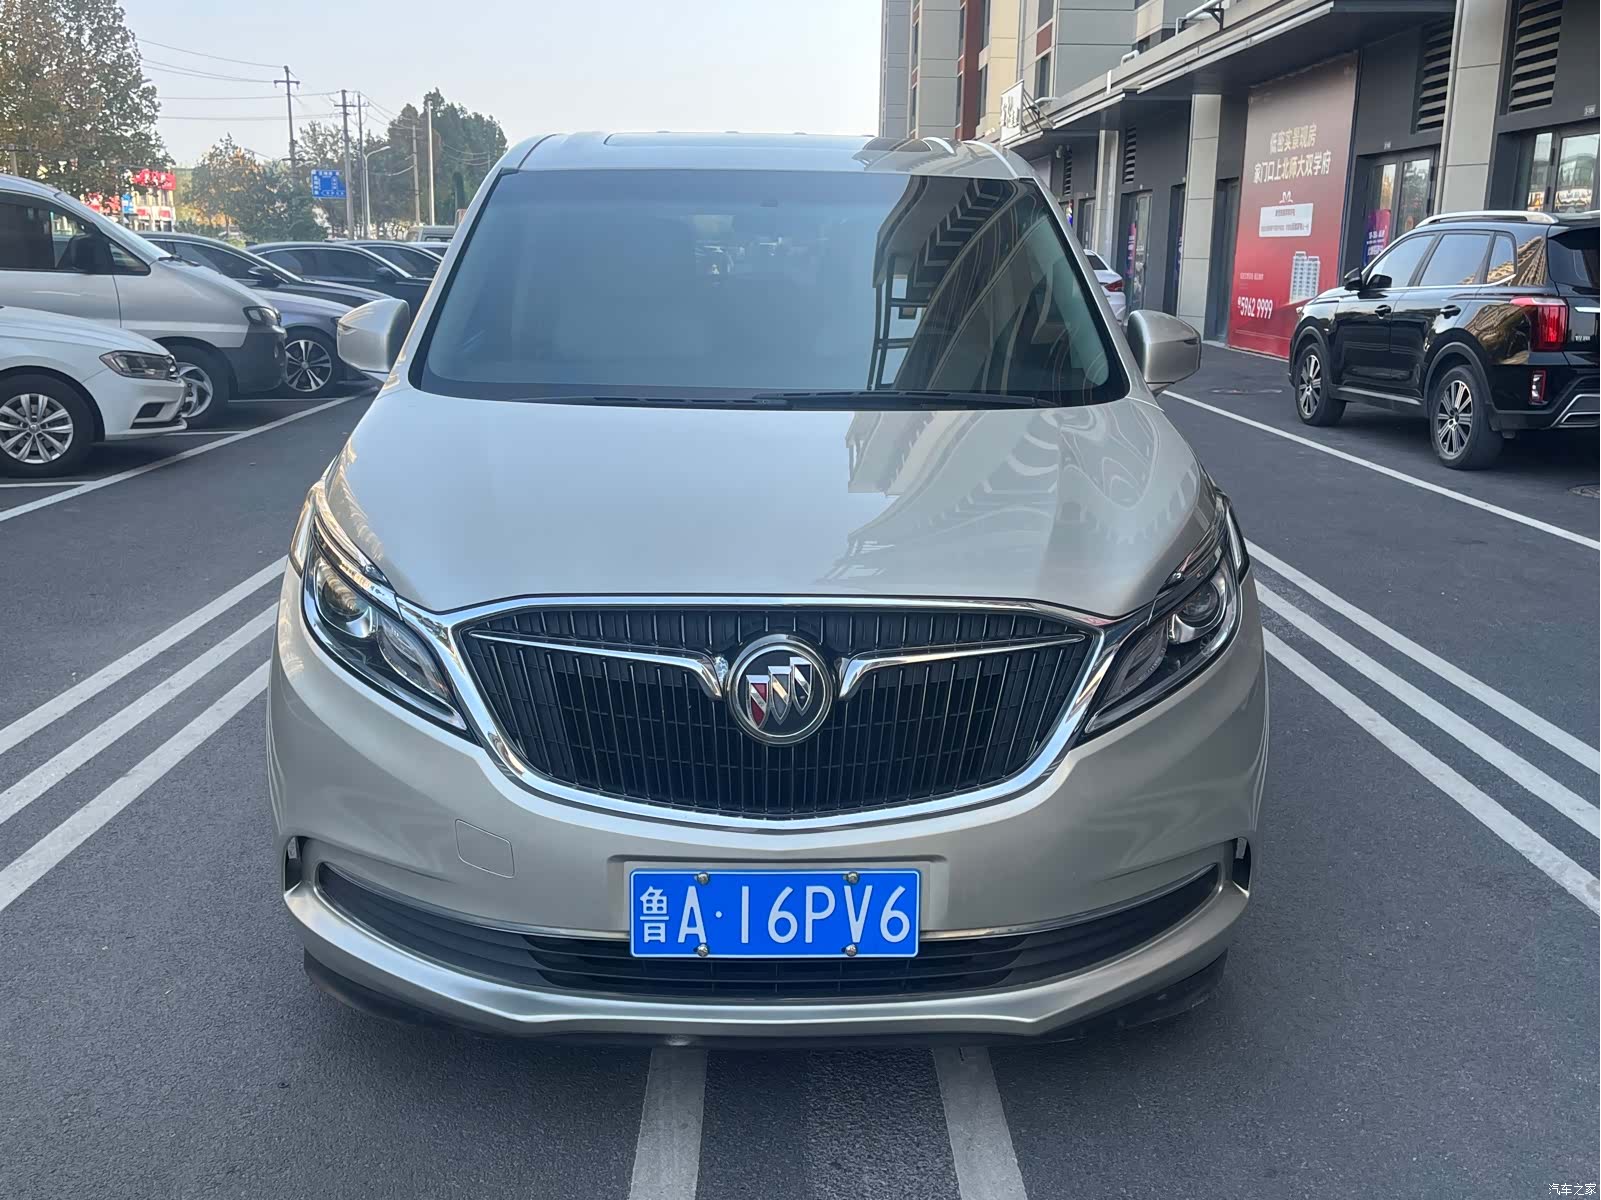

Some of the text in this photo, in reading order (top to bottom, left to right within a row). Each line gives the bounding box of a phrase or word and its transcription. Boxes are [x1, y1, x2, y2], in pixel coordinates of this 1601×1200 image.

[1270, 122, 1317, 154] 低密实景现房
[1253, 149, 1332, 184] 家门口上北师大双学府
[1240, 296, 1256, 317] 5962
[1257, 298, 1273, 319] 9999
[639, 885, 911, 944] 鲁A·16PV6
